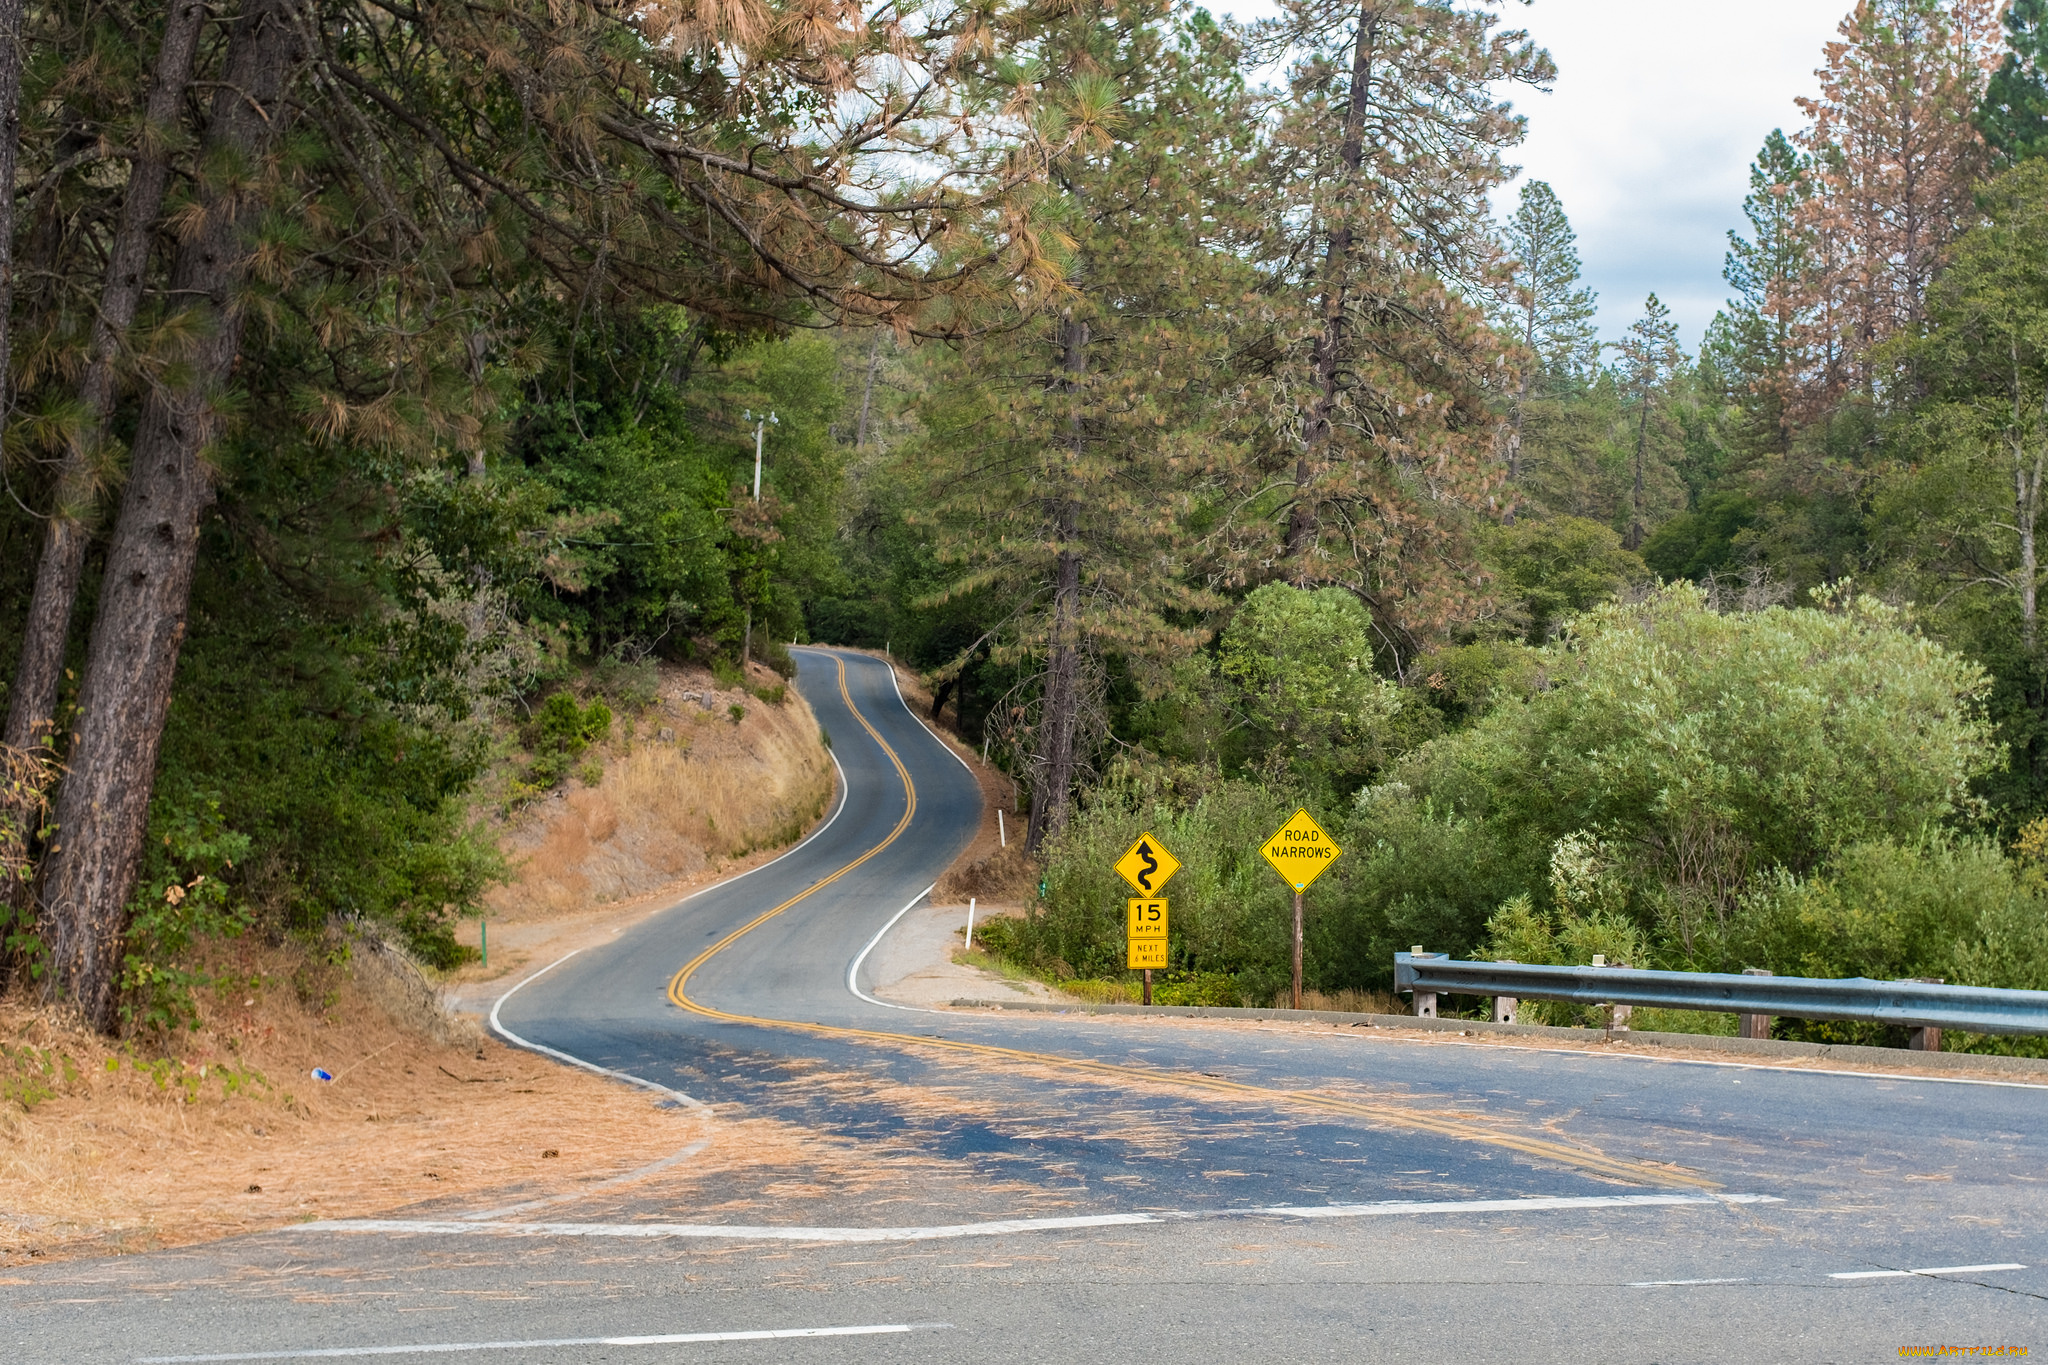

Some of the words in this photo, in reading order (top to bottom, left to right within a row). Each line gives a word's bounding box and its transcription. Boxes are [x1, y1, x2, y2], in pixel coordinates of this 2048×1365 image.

[1285, 830, 1319, 841] ROAD
[1272, 846, 1331, 858] NARROWS
[1136, 904, 1161, 921] 15
